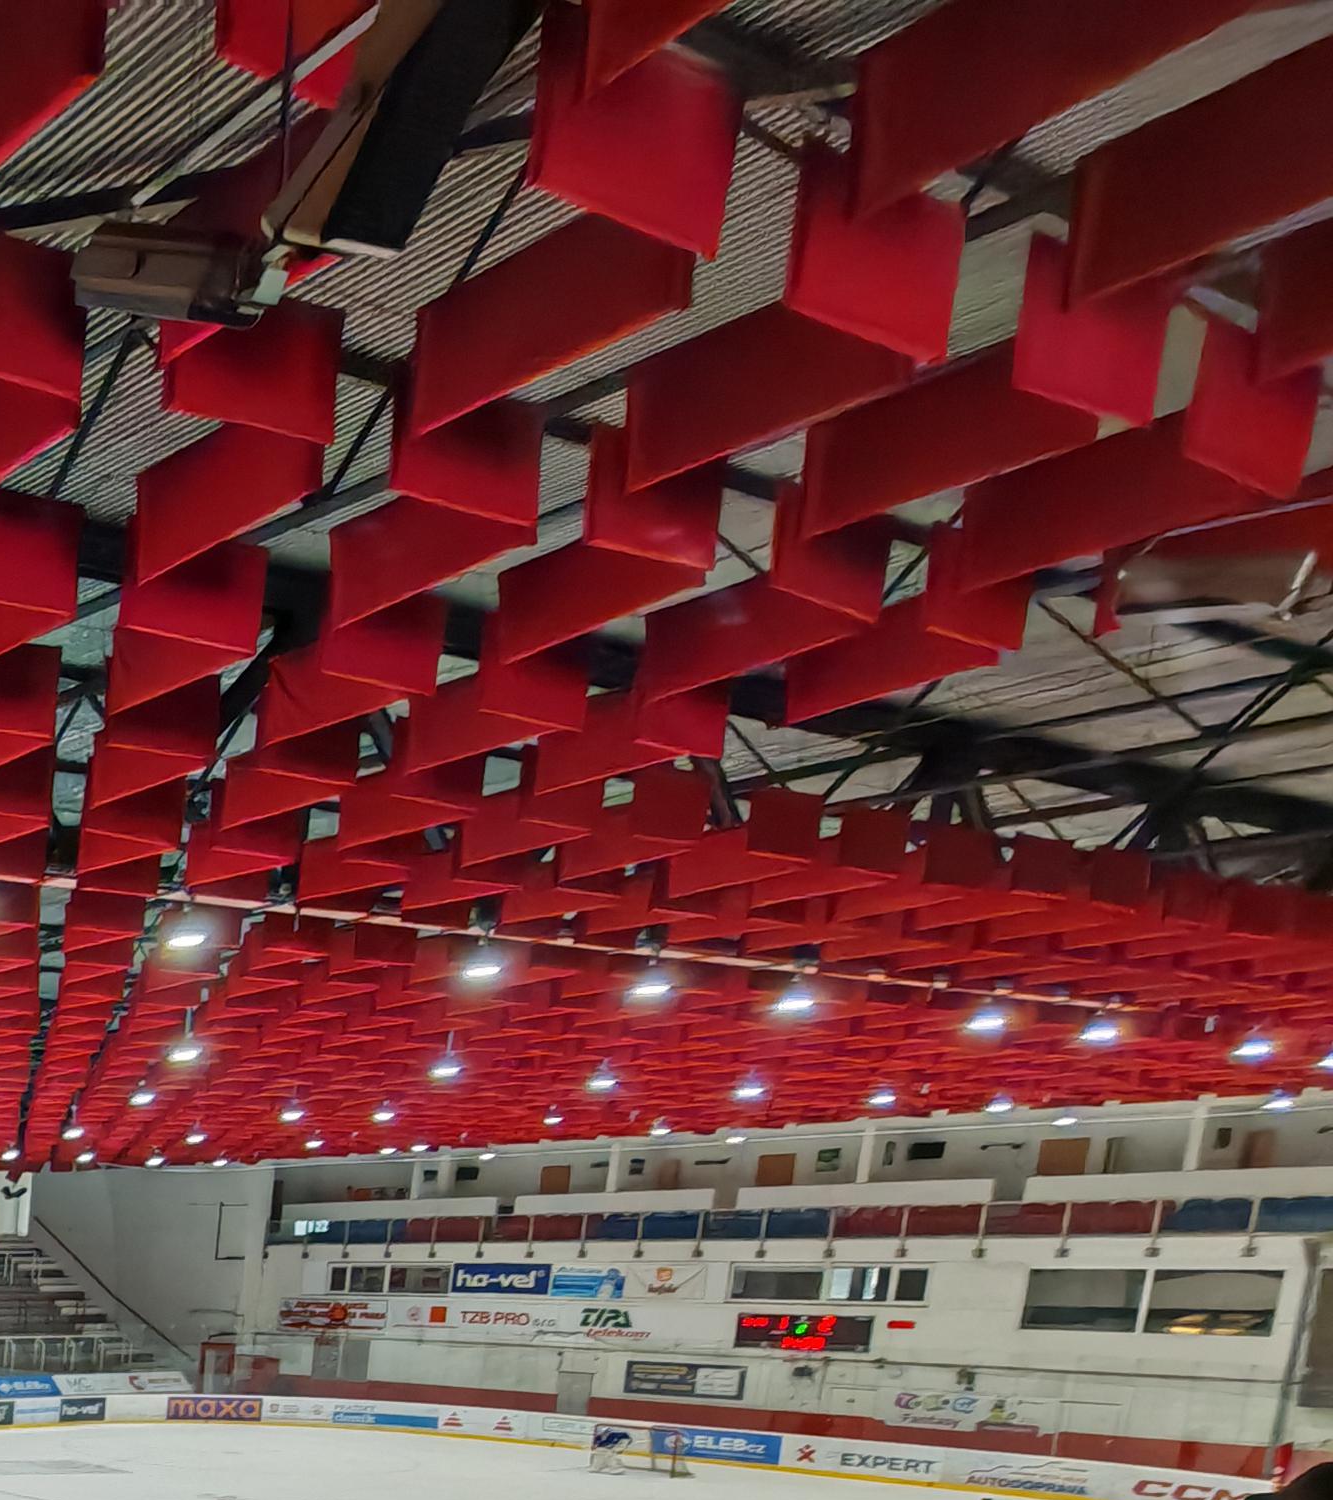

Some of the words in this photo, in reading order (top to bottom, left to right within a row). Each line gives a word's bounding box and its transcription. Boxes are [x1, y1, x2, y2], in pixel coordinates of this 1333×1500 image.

[461, 1311, 491, 1324] TZB
[492, 1312, 530, 1326] PRO
[579, 1308, 633, 1328] TIPA
[586, 1328, 652, 1338] telekom
[168, 1399, 261, 1419] maxa
[840, 1452, 934, 1474] EXPERT
